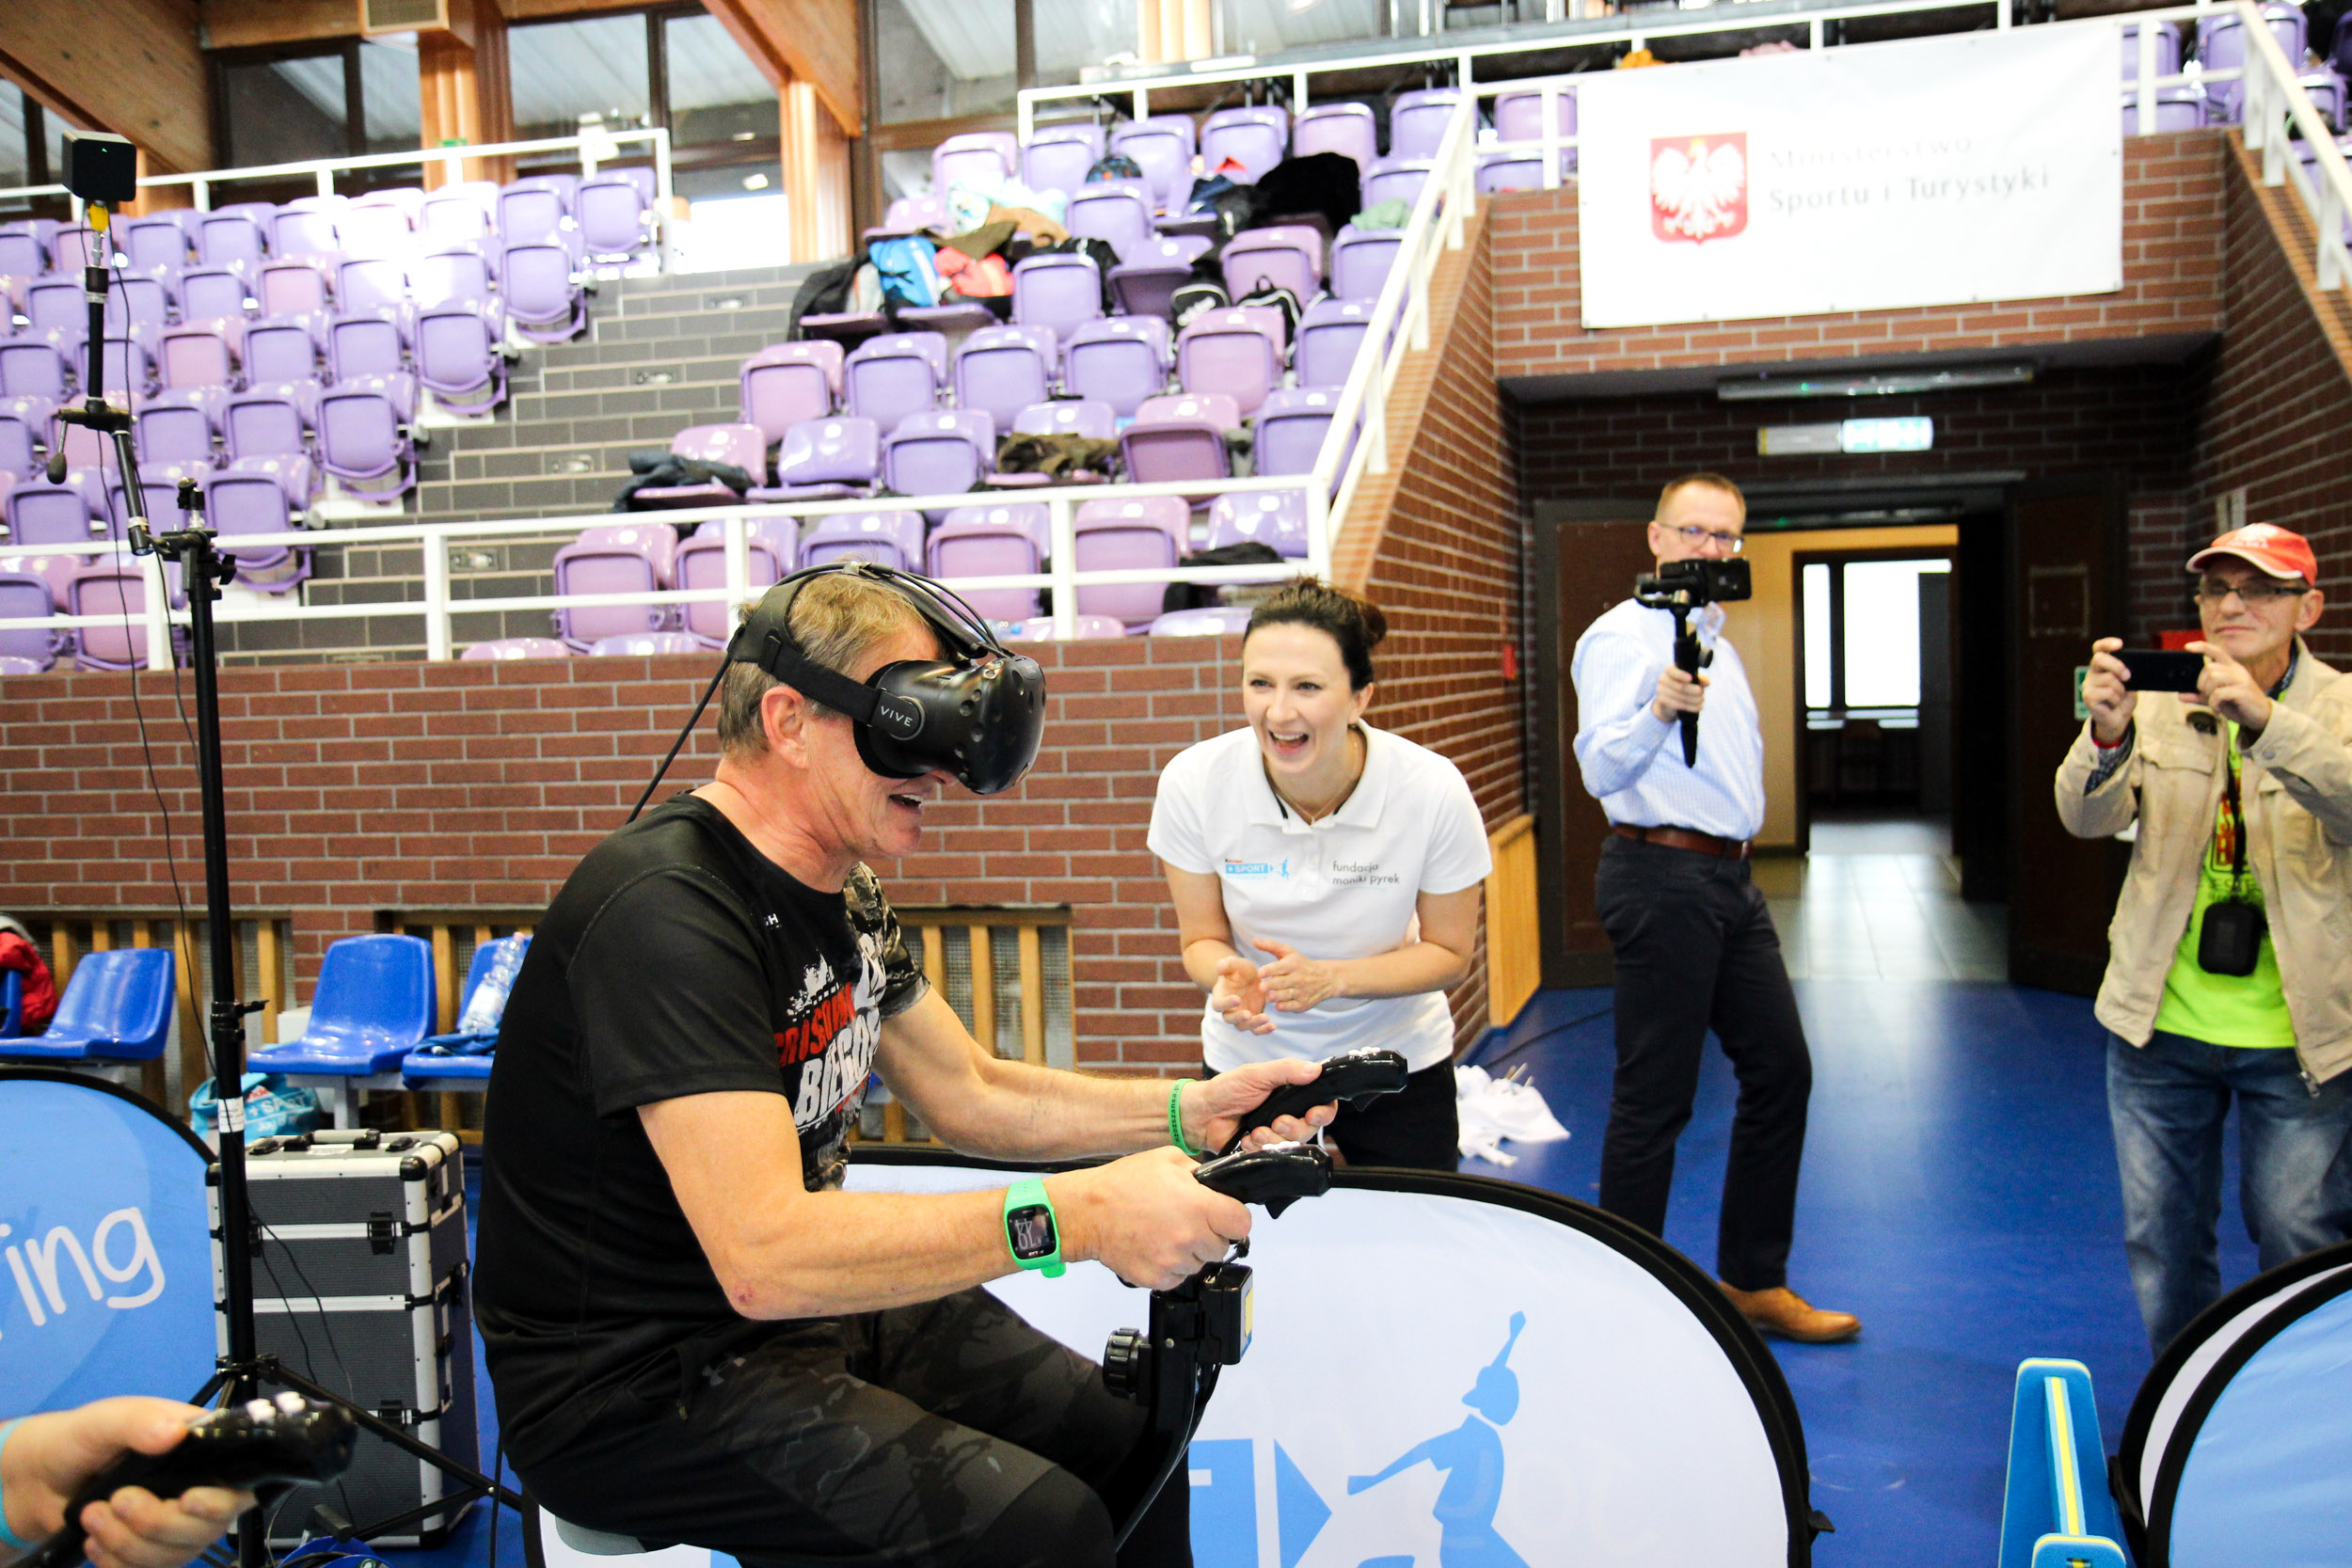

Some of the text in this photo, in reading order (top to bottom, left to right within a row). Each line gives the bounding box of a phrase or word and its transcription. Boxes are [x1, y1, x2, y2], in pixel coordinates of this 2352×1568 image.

[1769, 163, 2050, 215] Sportu i Turystyki
[881, 705, 914, 727] VIVE
[1332, 860, 1378, 873] fundacja
[1332, 873, 1400, 886] moniki pyrek
[0, 1207, 166, 1328] ing
